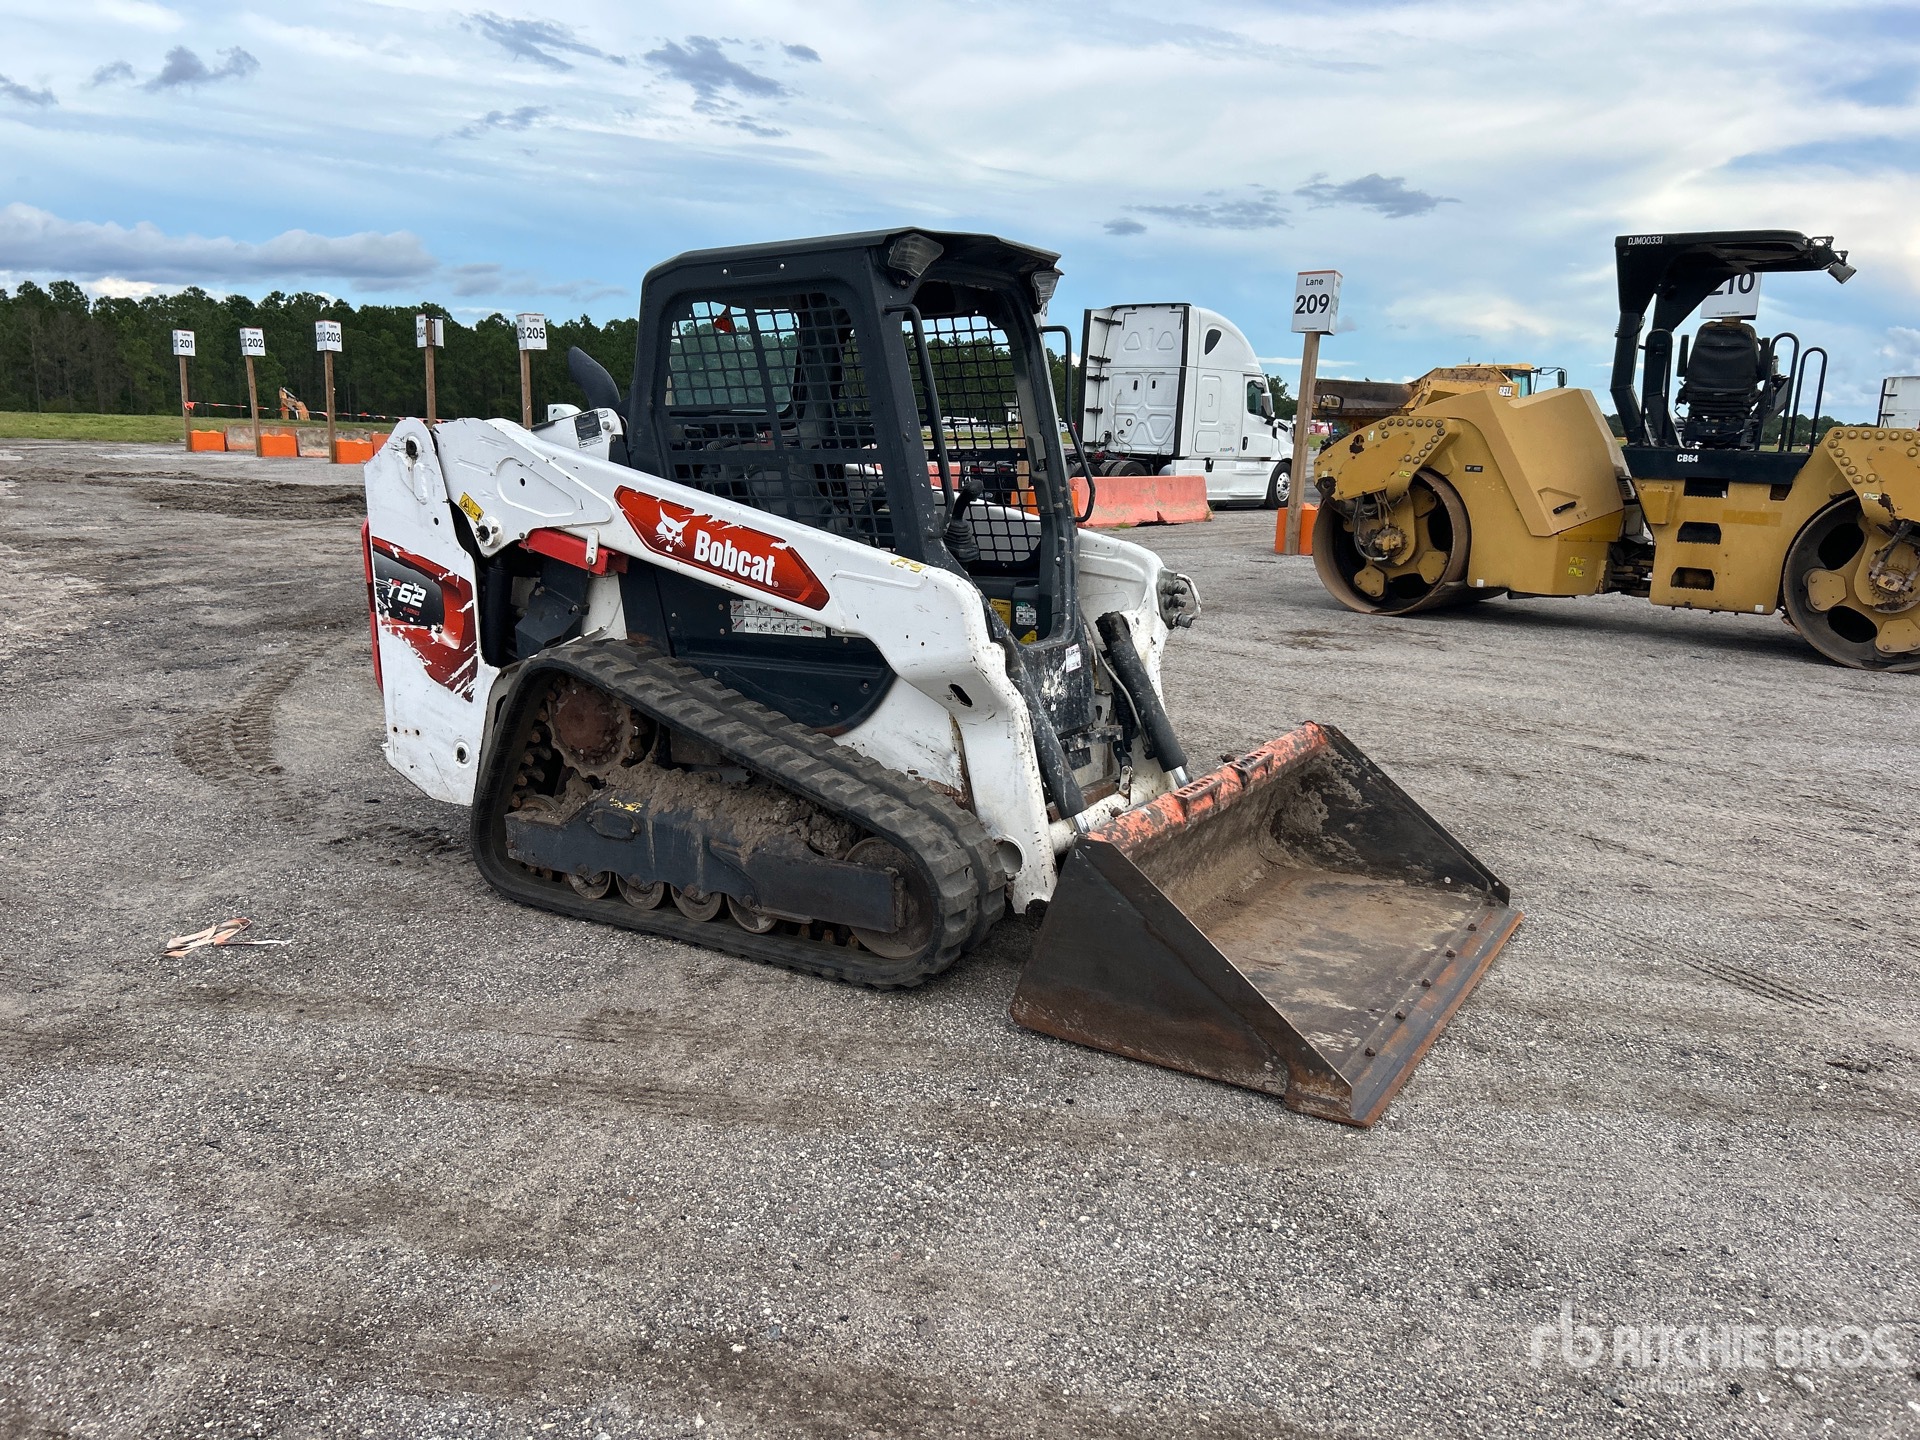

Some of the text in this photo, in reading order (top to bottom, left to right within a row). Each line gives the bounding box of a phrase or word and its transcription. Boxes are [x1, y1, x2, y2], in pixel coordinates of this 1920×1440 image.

[1305, 278, 1324, 287] Lane
[1707, 272, 1756, 295] 10
[1294, 293, 1330, 315] 209
[326, 331, 341, 343] 203
[526, 326, 546, 340] 205
[179, 338, 193, 349] 201
[247, 337, 264, 348] 202
[1676, 453, 1699, 463] CB64
[694, 529, 776, 587] Bobcat
